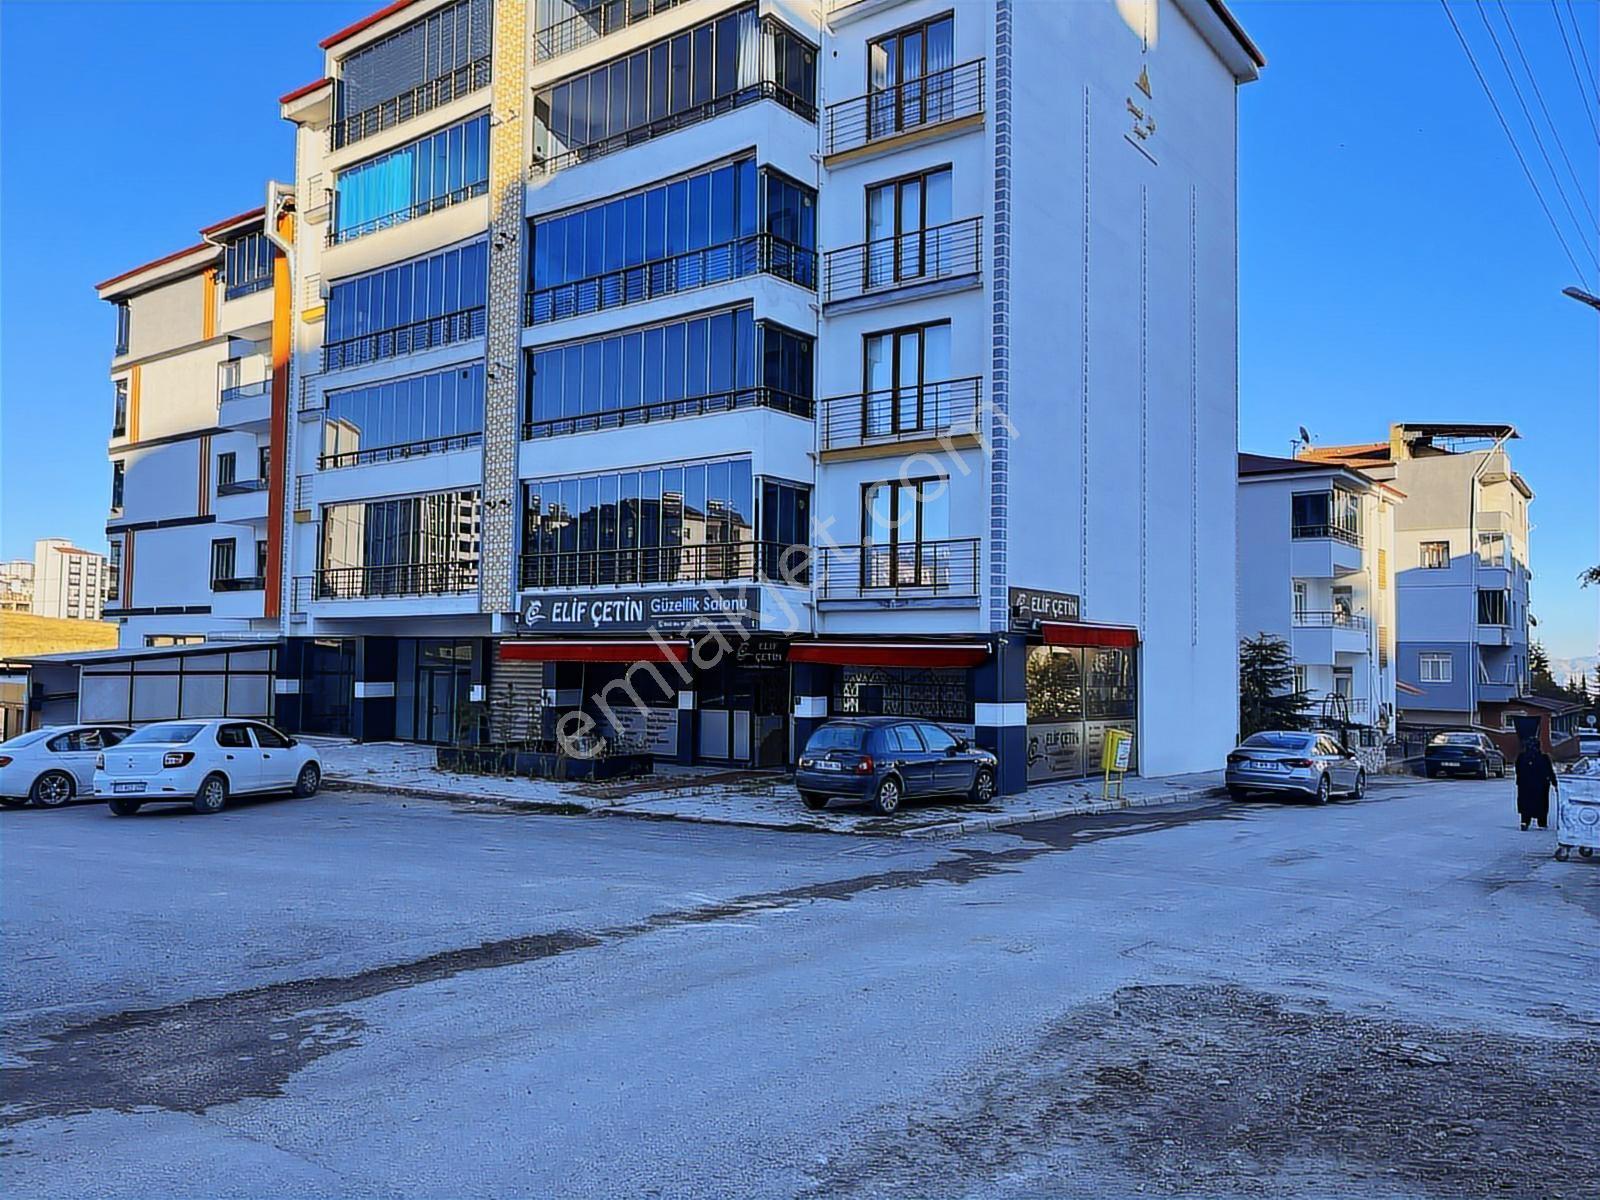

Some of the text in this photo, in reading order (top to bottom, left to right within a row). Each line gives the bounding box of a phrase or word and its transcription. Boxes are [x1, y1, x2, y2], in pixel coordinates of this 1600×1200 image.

[551, 596, 643, 627] ELİF ÇETİN
[650, 596, 748, 612] Güzellik Salonu
